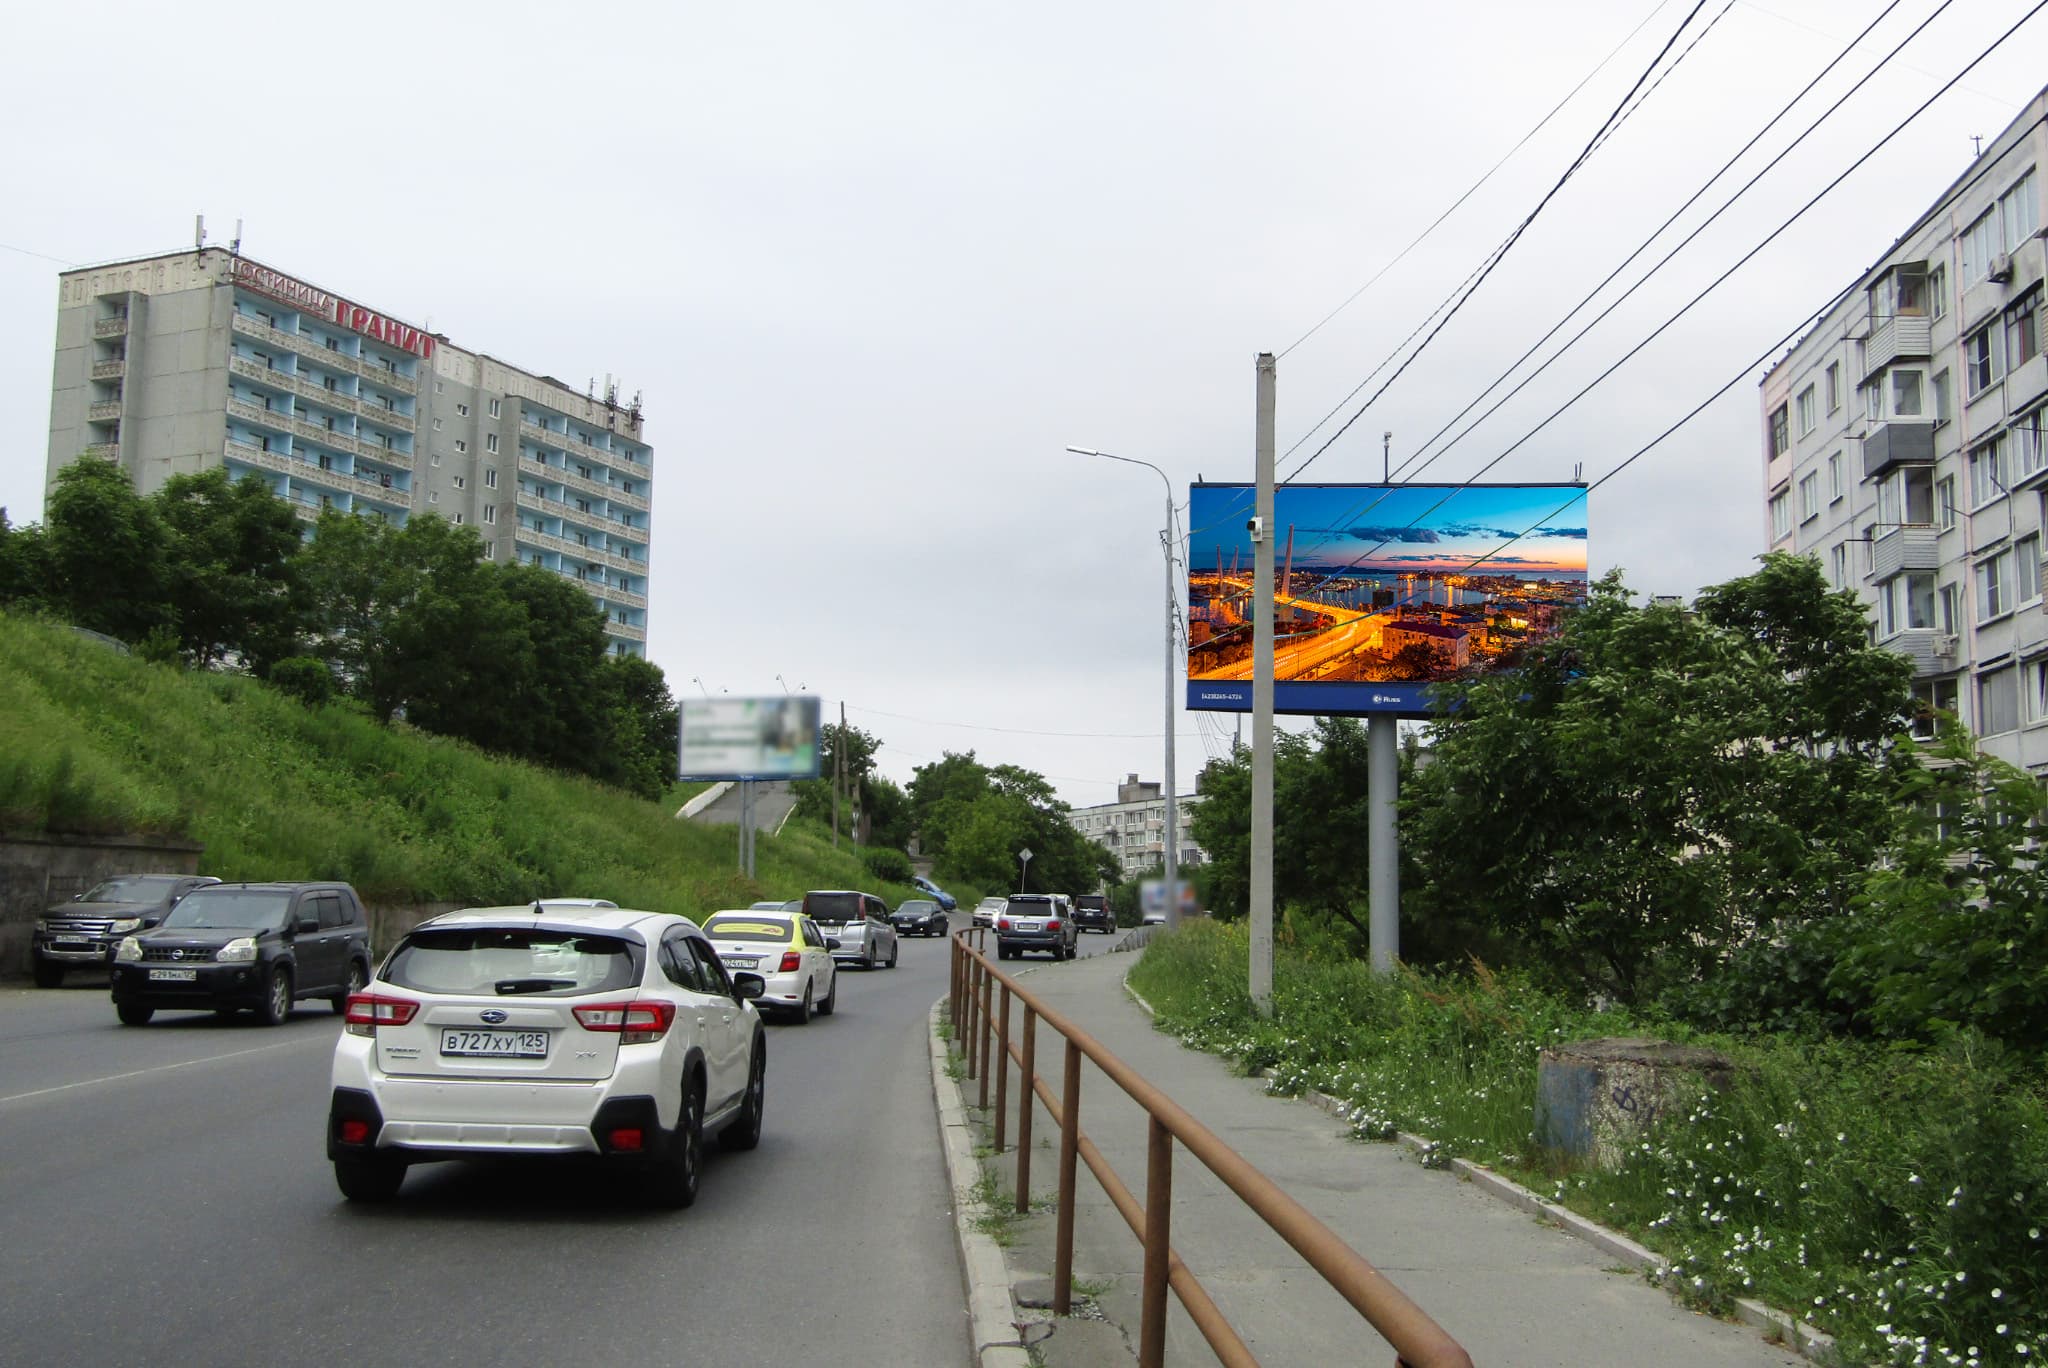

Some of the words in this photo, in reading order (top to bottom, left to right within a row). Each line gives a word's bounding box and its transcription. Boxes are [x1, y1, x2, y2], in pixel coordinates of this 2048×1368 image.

[232, 257, 331, 309] ГОСТИНИЦА
[335, 299, 436, 359] ГРАНИТ
[447, 1032, 514, 1051] В727ХУ
[518, 1034, 545, 1048] 125
